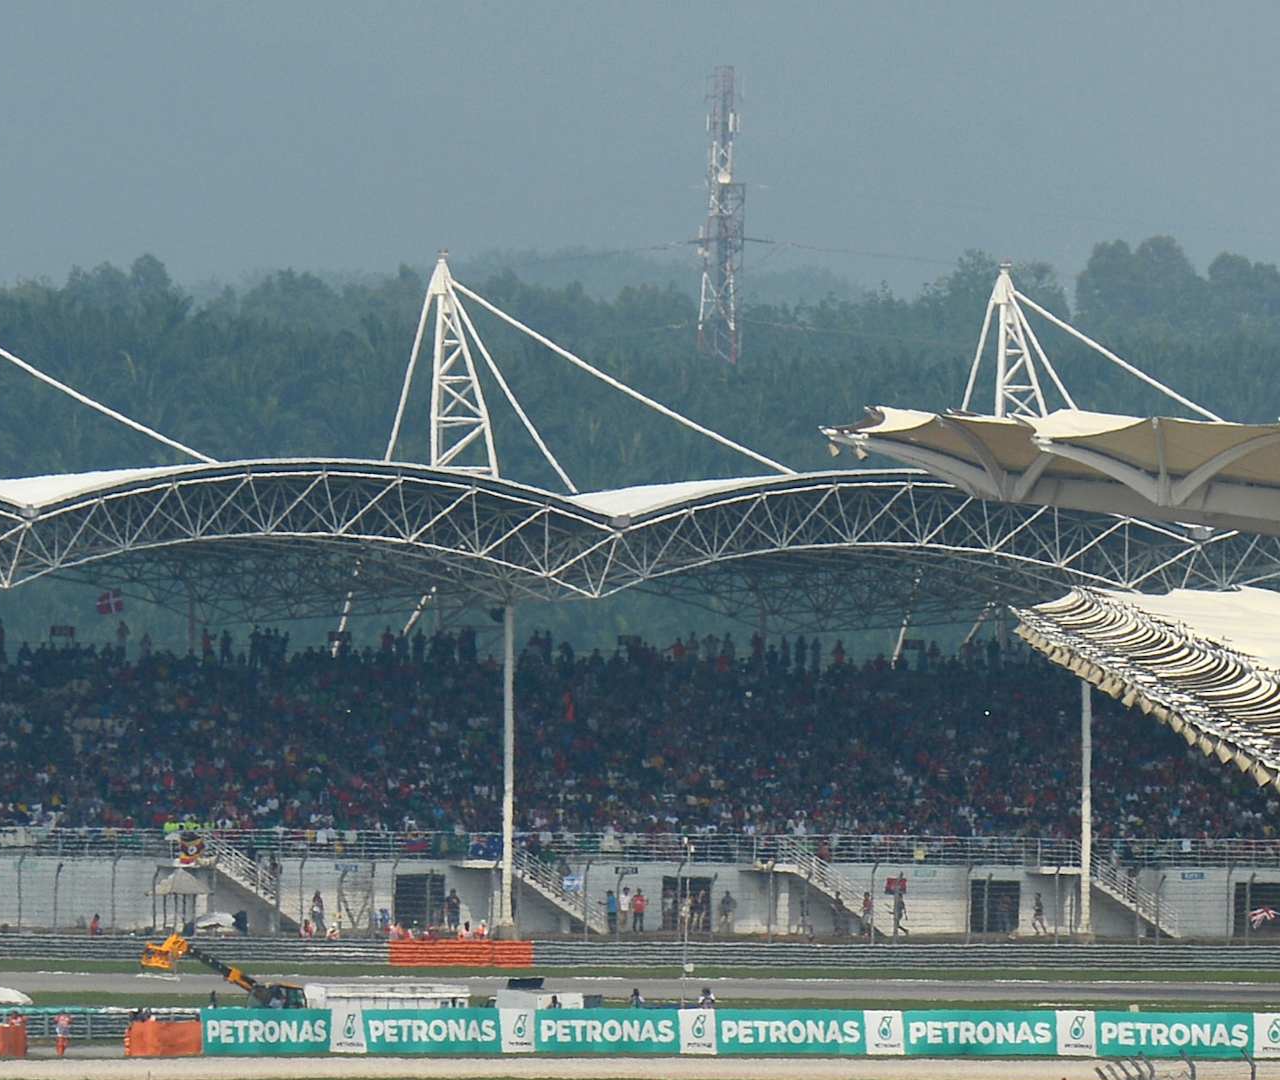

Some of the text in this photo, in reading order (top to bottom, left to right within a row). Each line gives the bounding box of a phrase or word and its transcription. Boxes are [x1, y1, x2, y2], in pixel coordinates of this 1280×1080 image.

[206, 1019, 327, 1044] PETRONAS
[369, 1019, 497, 1043] PETRONAS
[540, 1019, 676, 1043] PETRONAS
[721, 1020, 861, 1044] PETRONAS
[909, 1021, 1053, 1045] PETRONAS
[1101, 1022, 1249, 1048] PETRONAS
